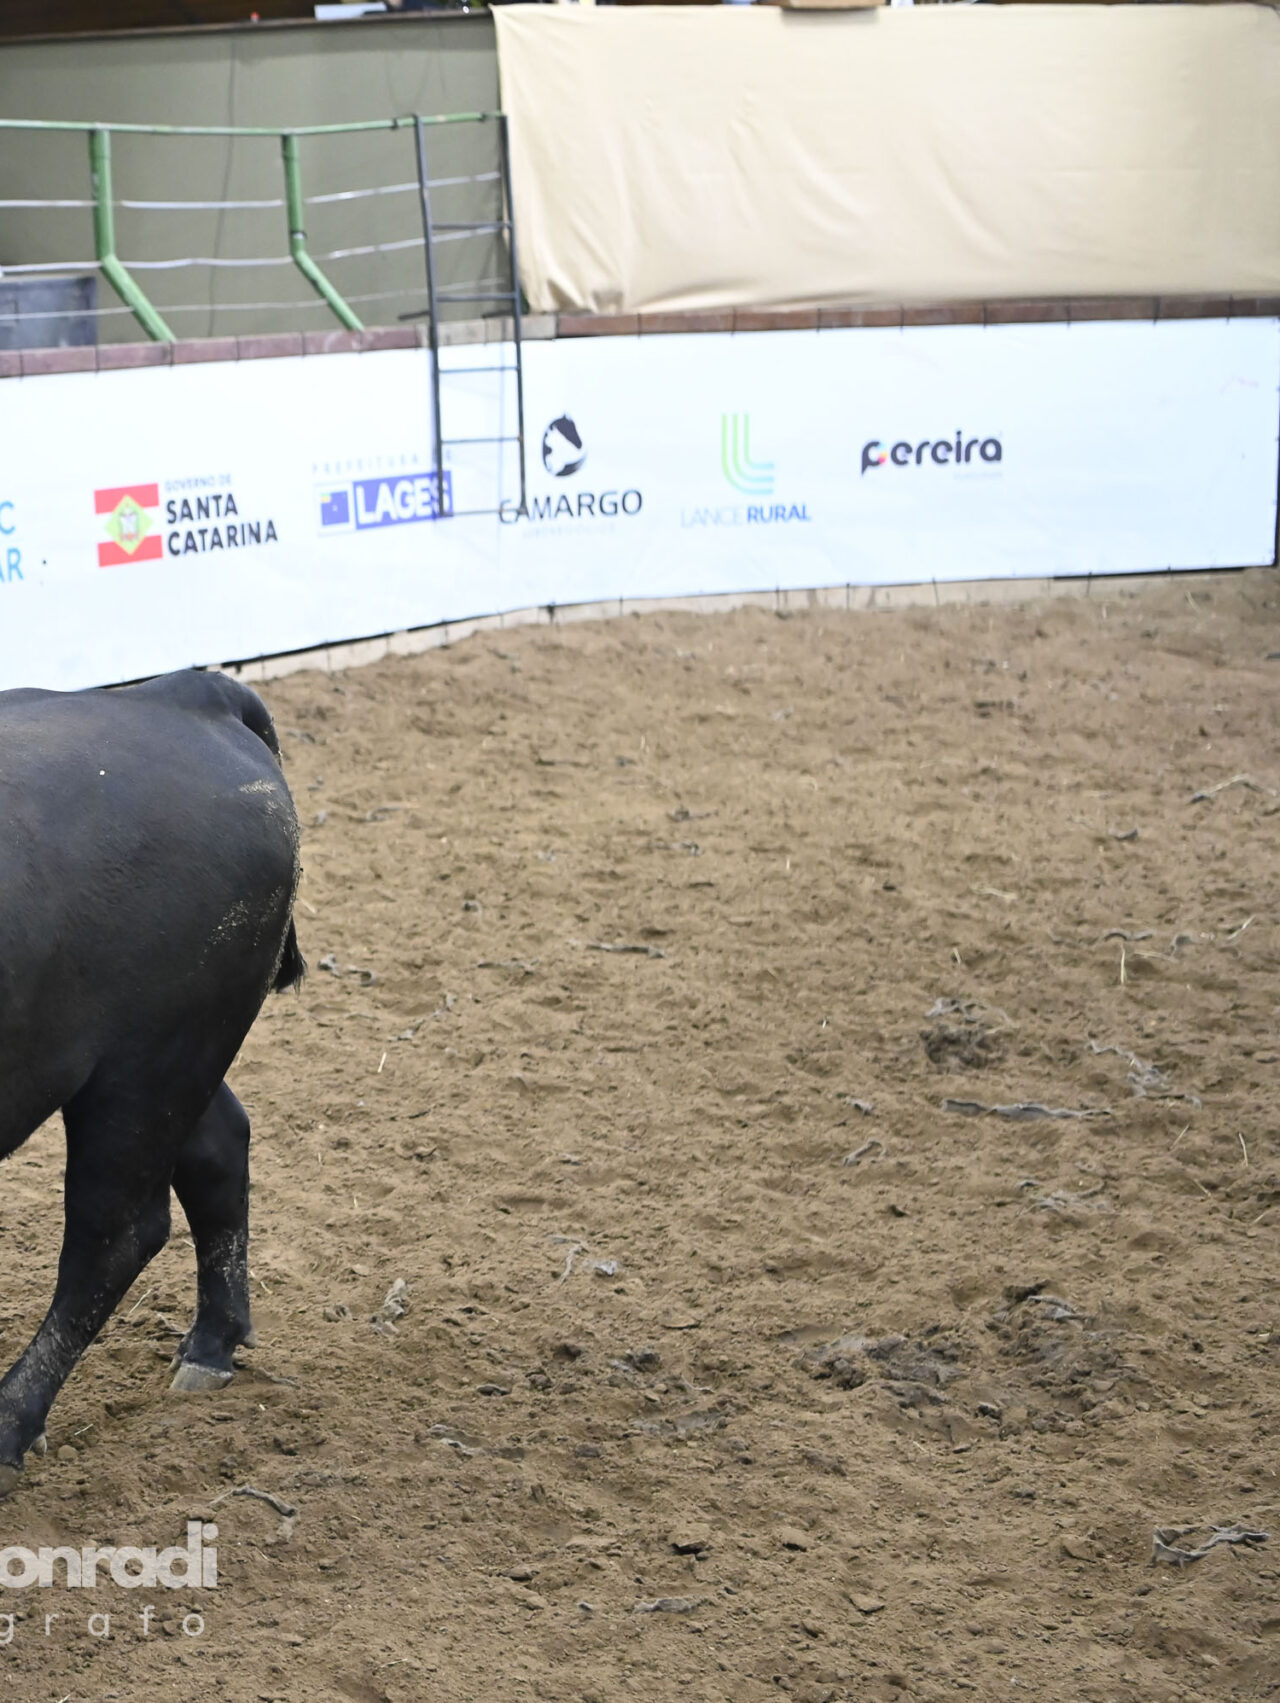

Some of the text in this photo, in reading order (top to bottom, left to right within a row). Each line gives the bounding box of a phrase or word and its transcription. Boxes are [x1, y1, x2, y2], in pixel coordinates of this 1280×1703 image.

[861, 430, 1002, 475] pereira
[166, 493, 238, 524] SANTA
[355, 477, 451, 524] LAGES
[747, 501, 812, 523] RURAL
[168, 520, 278, 556] CATARINA
